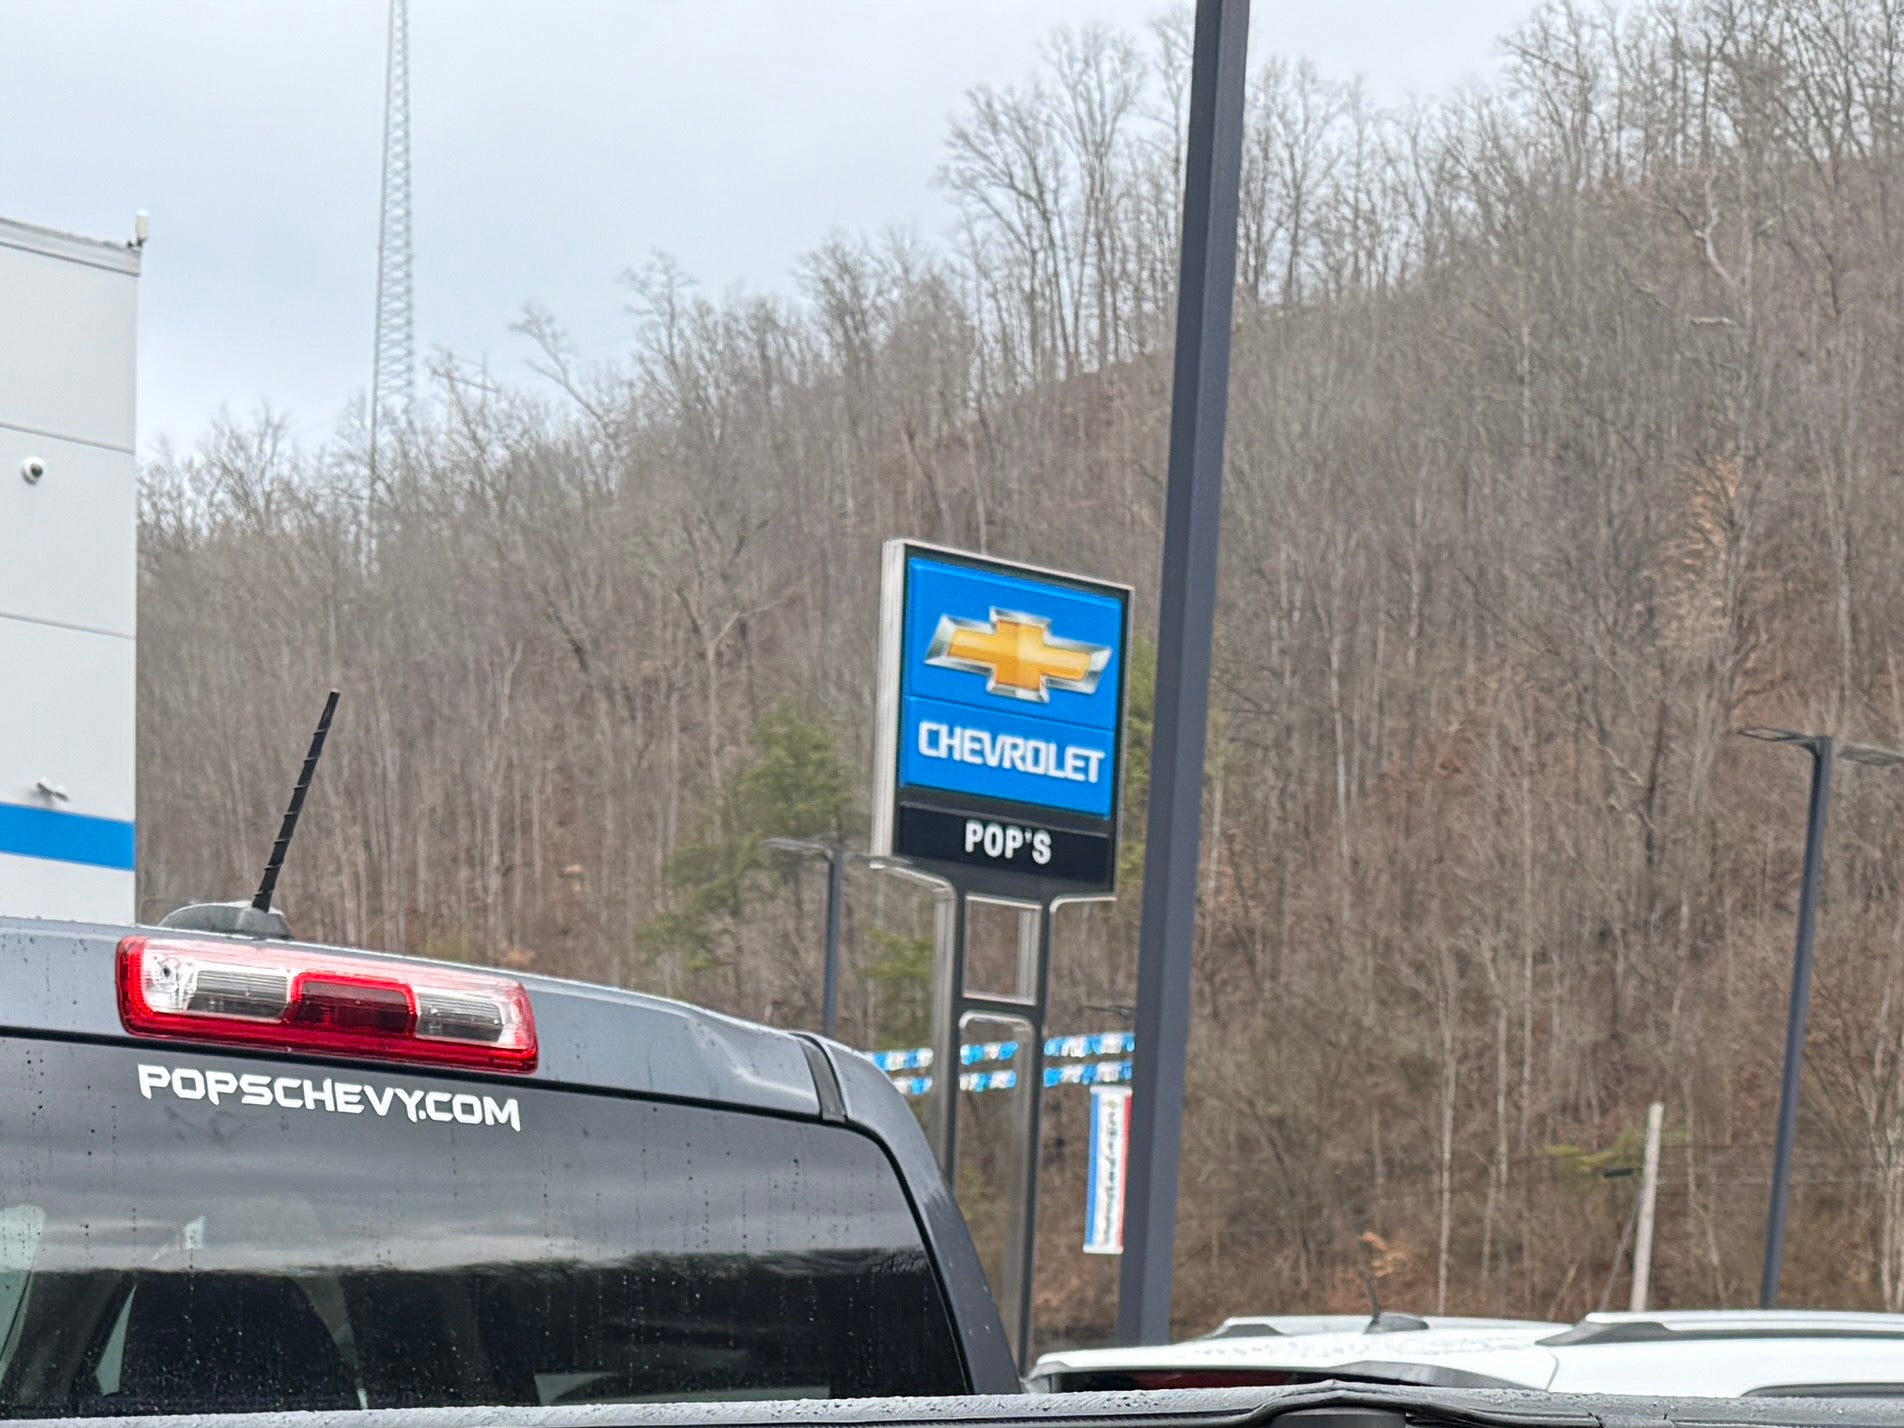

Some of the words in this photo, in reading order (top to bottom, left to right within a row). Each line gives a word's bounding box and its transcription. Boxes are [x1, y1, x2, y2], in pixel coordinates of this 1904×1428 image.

[918, 720, 1105, 784] CHEVROLET
[964, 819, 1052, 865] POP'S
[136, 1063, 522, 1132] POPSCHEVY.COM
